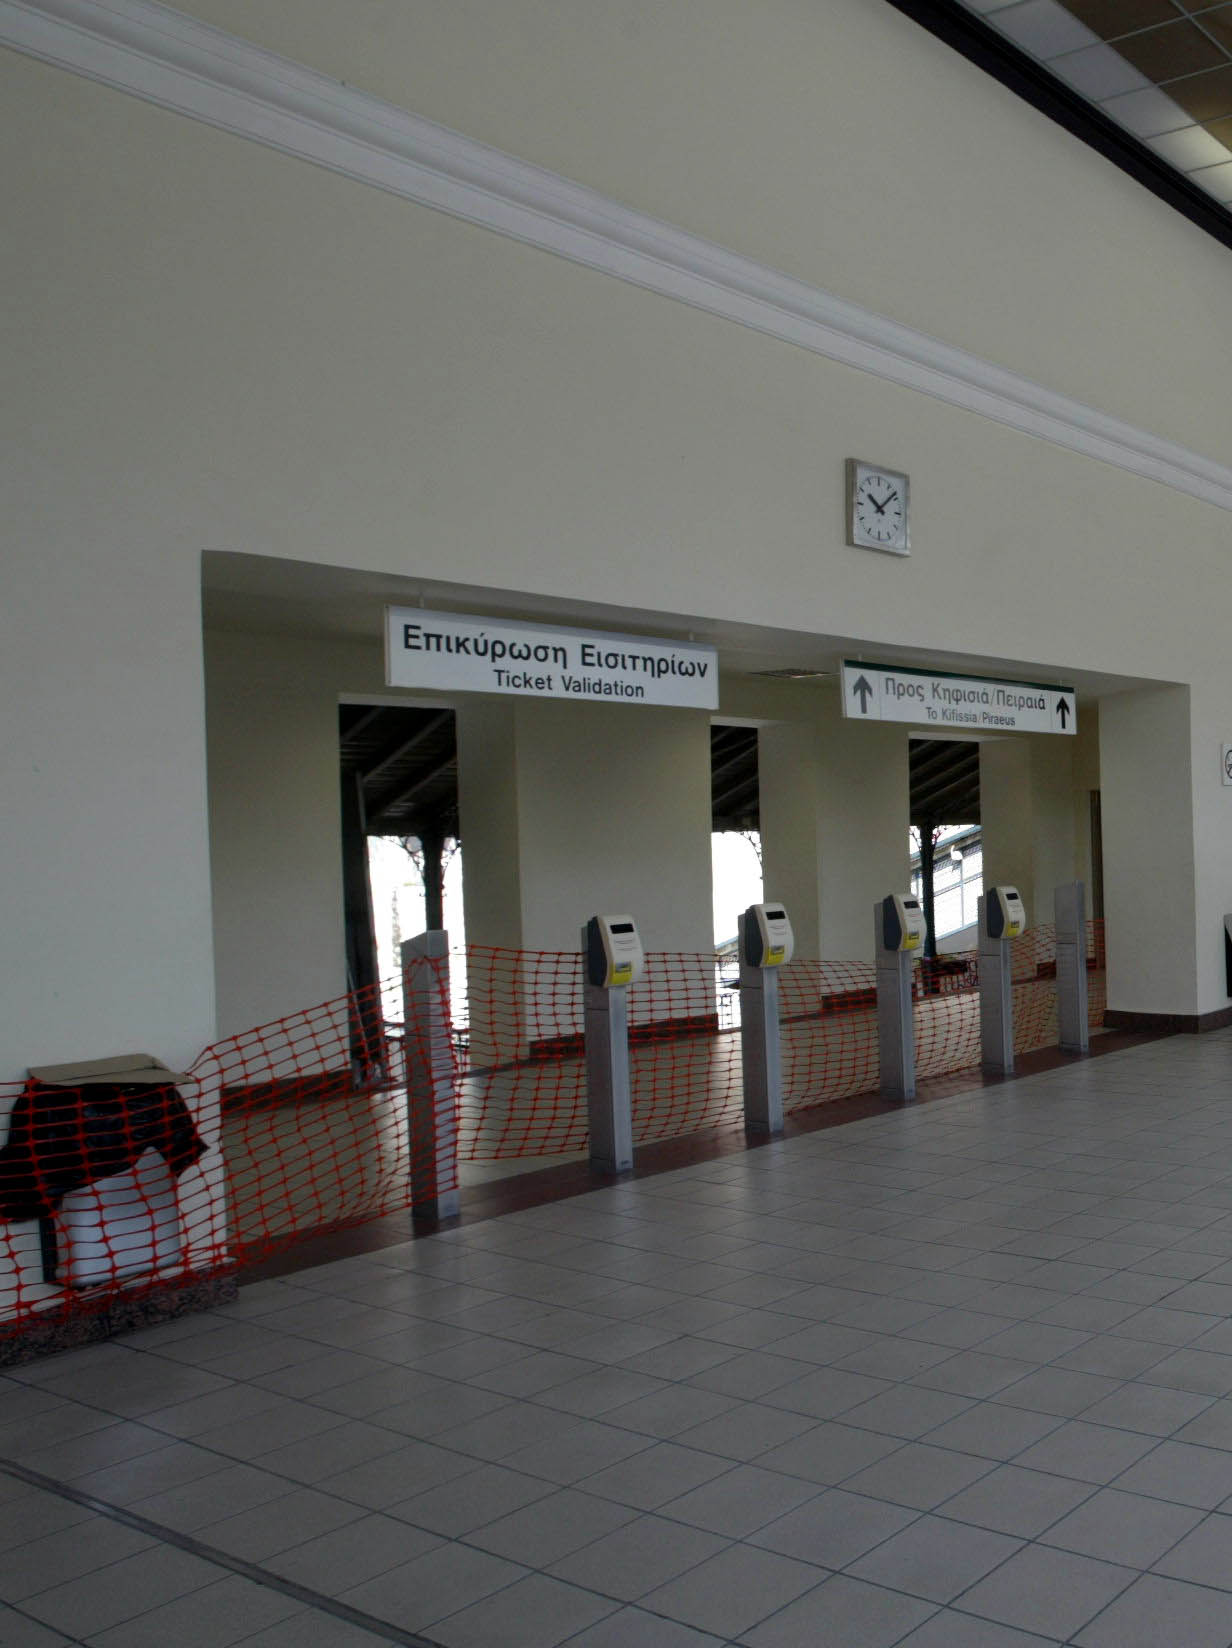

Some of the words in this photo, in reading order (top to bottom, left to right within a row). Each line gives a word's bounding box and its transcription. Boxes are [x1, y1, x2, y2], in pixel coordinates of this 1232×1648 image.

[404, 624, 568, 669] Επικύρωση
[580, 644, 708, 678] Εισιτηρίων
[493, 669, 553, 690] Ticket
[561, 675, 645, 698] Validation
[885, 677, 925, 702] Προς
[926, 706, 938, 720] To
